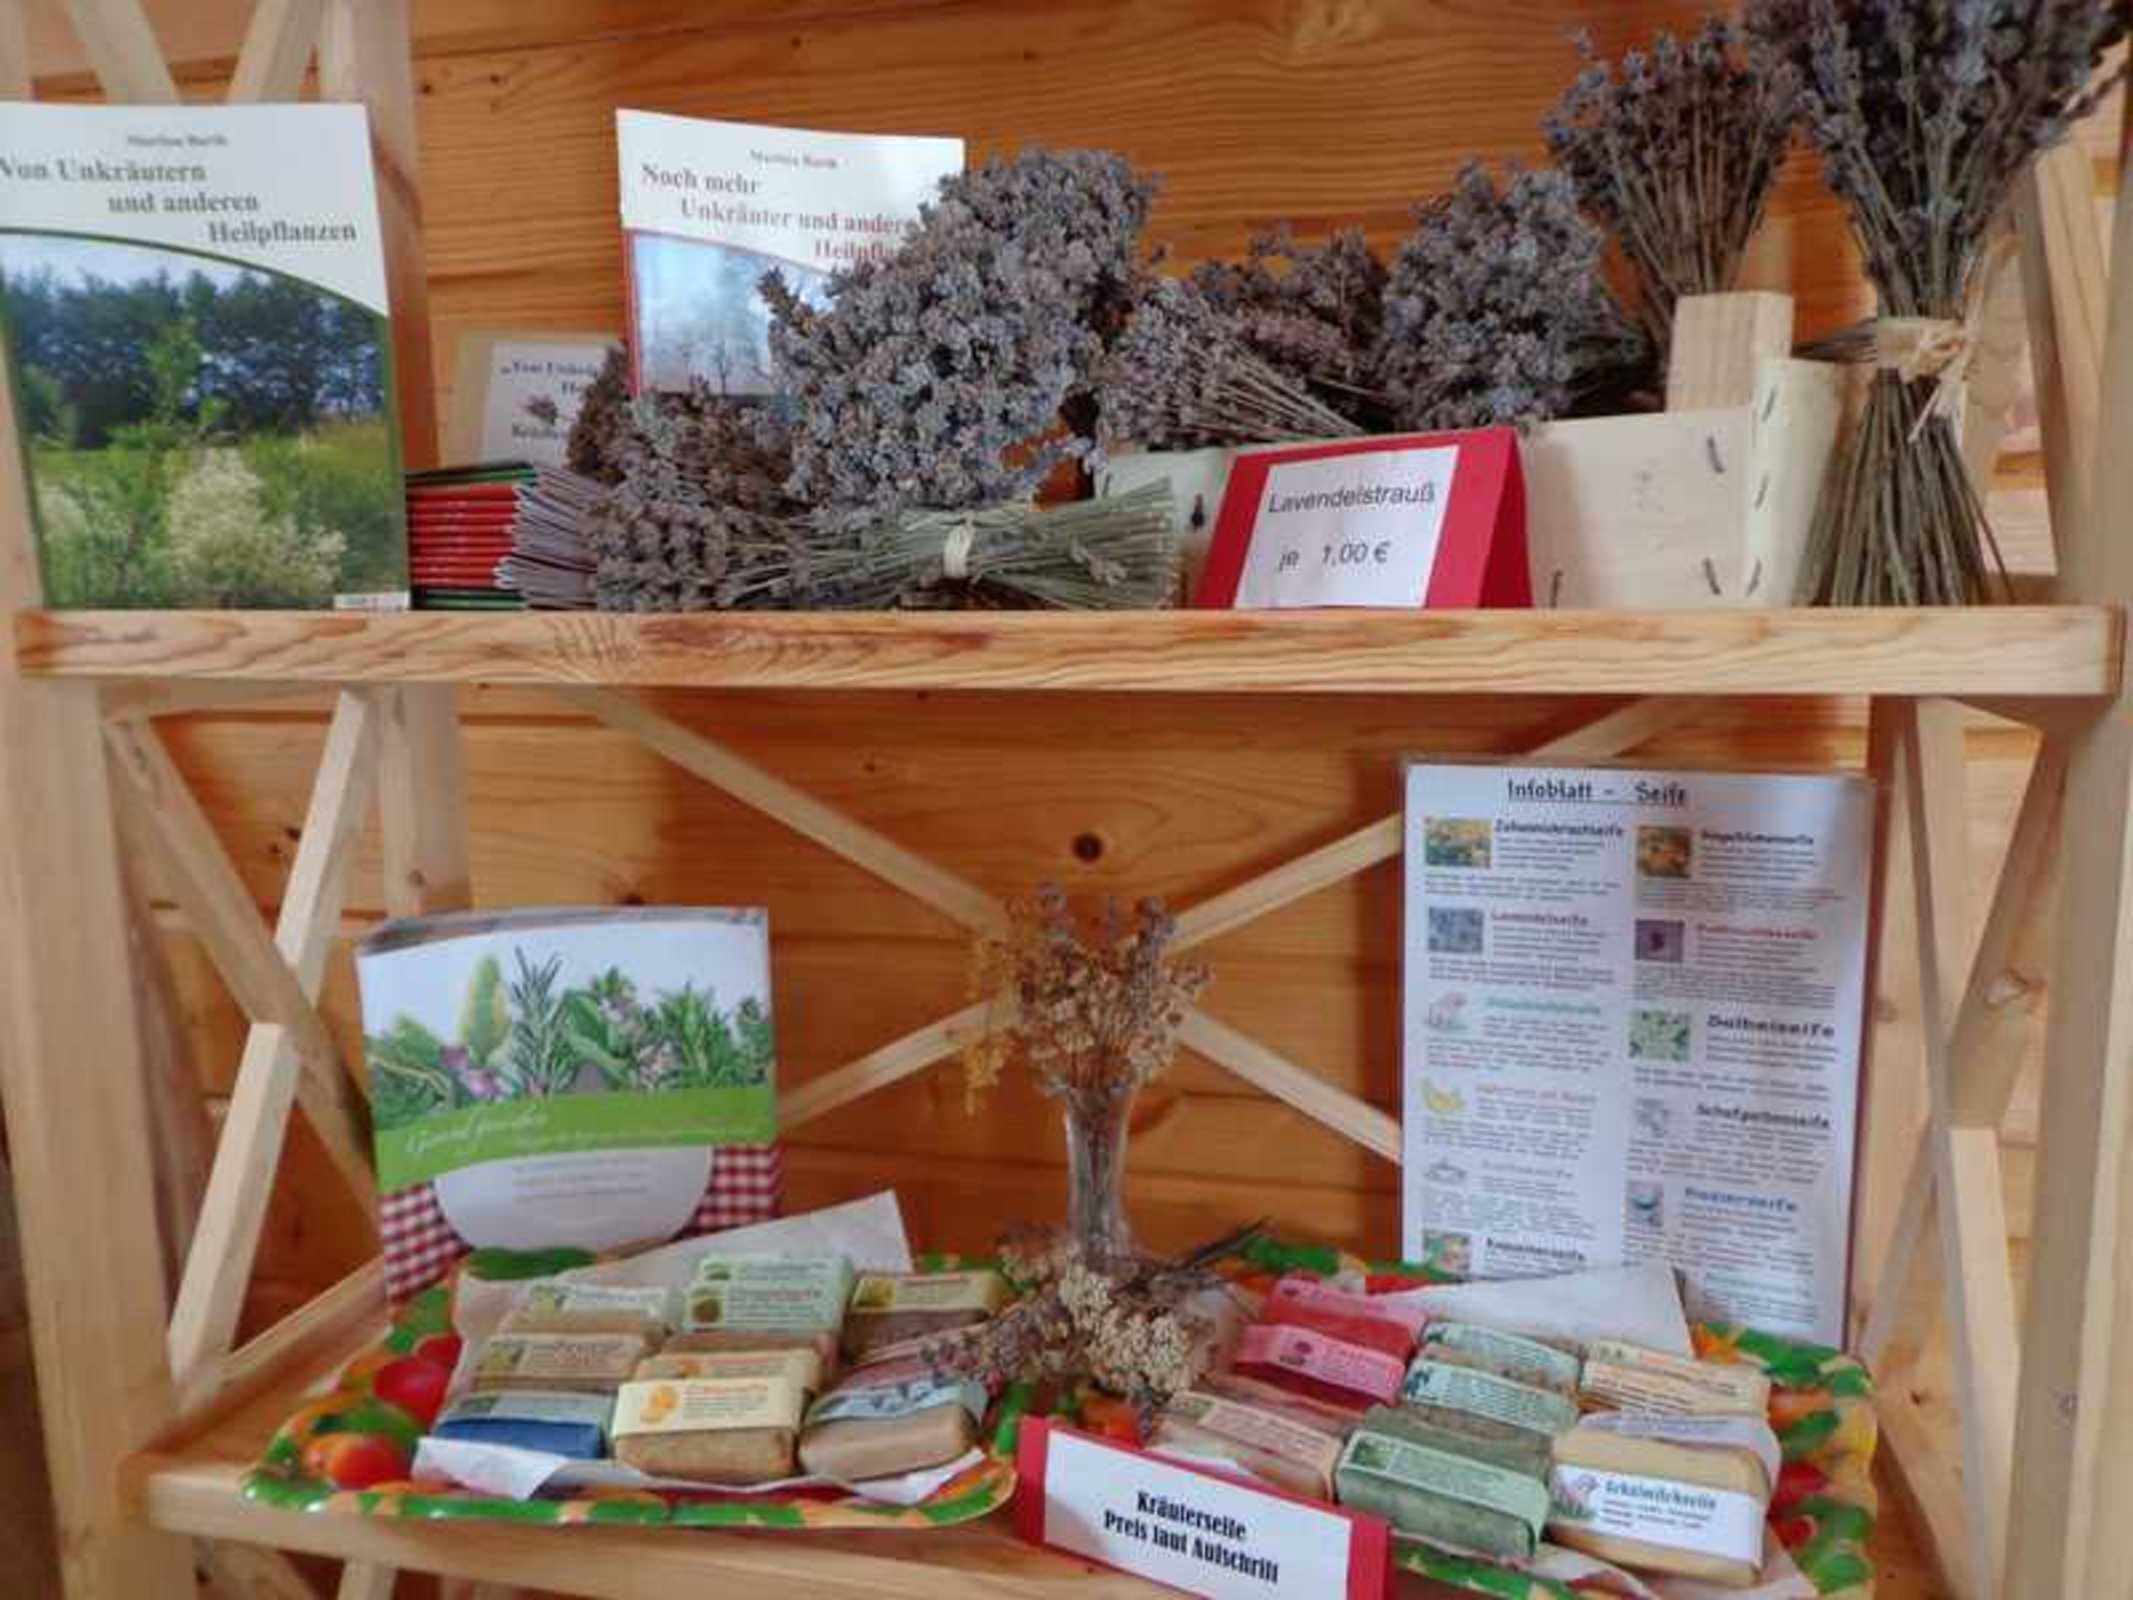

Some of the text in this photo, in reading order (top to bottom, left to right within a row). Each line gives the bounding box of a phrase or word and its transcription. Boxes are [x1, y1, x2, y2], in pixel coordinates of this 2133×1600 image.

[58, 158, 207, 184] Unkräutern
[641, 162, 761, 196] Noch mehr
[108, 192, 259, 214] und anderen
[680, 198, 792, 230] Unkräuter
[799, 211, 838, 232] und
[208, 220, 357, 248] Heilpflanzen
[1268, 480, 1436, 513] Lavendelstrauß
[1278, 541, 1392, 573] je 1,00 €
[1507, 778, 1593, 801] Infoblatt
[1634, 781, 1688, 808] Seife
[1136, 1490, 1247, 1543] Kräuterseife
[1103, 1509, 1280, 1585] Preis laut Aufschrift
